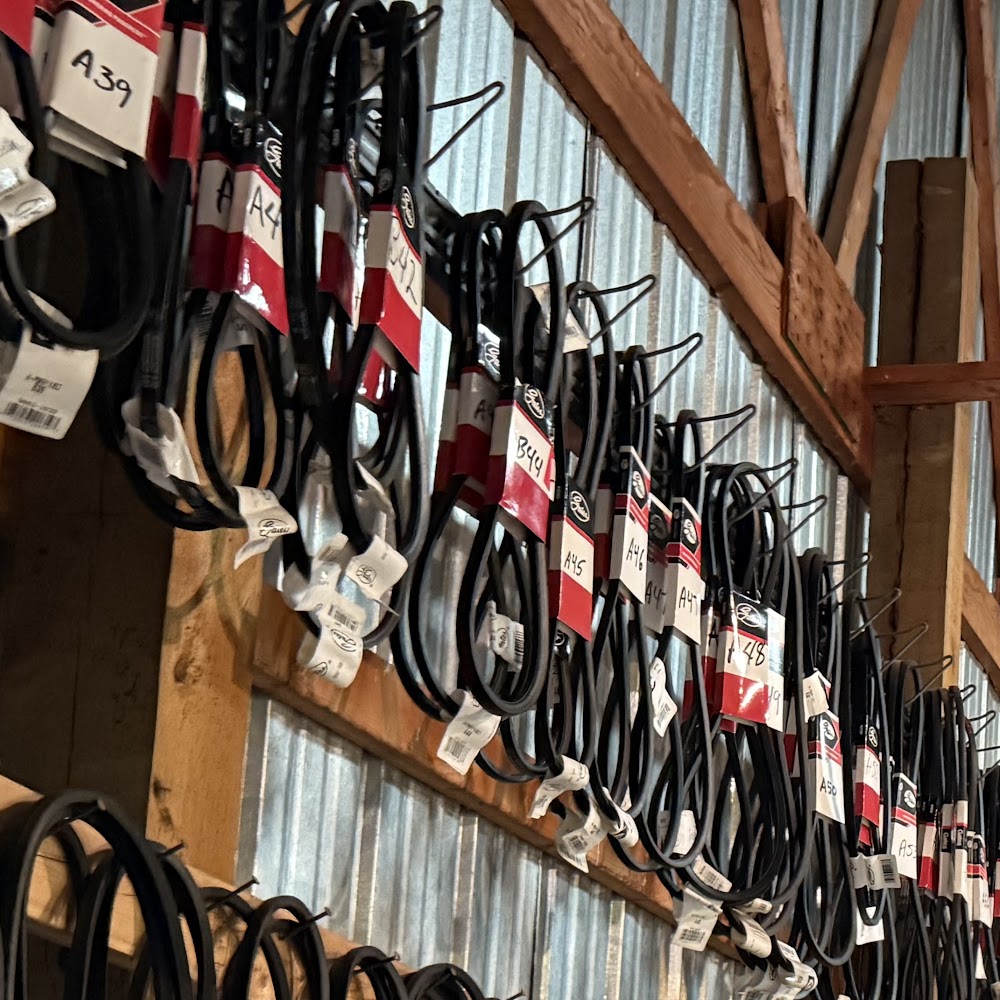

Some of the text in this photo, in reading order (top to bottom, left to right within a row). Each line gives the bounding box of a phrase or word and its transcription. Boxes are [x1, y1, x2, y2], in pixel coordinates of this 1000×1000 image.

[71, 49, 133, 108] A39
[516, 435, 544, 478] B44
[564, 550, 587, 577] A45
[626, 537, 645, 571] A46
[820, 779, 837, 797] A50
